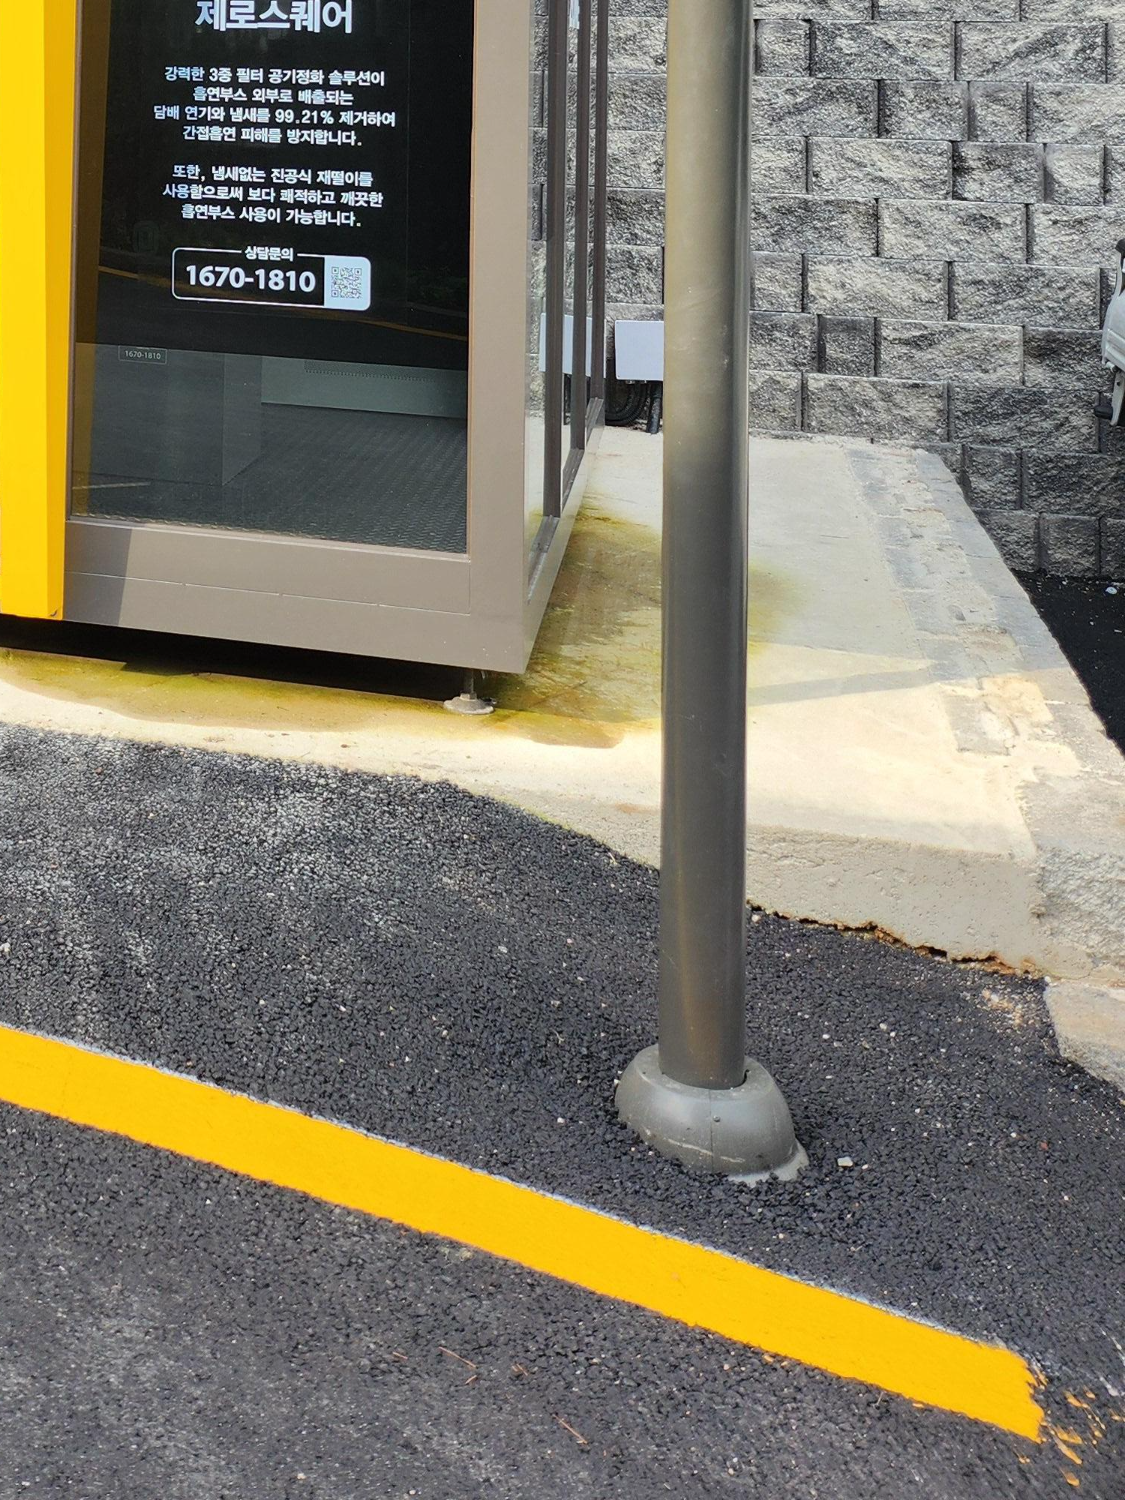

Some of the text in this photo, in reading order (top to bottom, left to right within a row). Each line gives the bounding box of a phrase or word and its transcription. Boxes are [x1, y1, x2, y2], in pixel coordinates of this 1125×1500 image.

[164, 66, 385, 87] 강력한 3중 필터 공기정화 솔루션이
[193, 86, 354, 106] 흡연부스 외부로 배출되는
[153, 105, 396, 127] 담배 연기와 냄새를 99.21% 제거하여
[182, 125, 362, 146] 간접흡연 피해를 방지합니다.
[172, 164, 373, 187] 또한, 냄새없는 진공식 재떨이를
[163, 183, 384, 208] 사용함으로써 보다 쾌적하고 깨끗한
[181, 203, 362, 227] 흡연부스 사용이 가능합니다.
[245, 246, 294, 261] 상담문의
[185, 265, 316, 293] 1670-1810
[125, 350, 162, 360] 1670-1810
